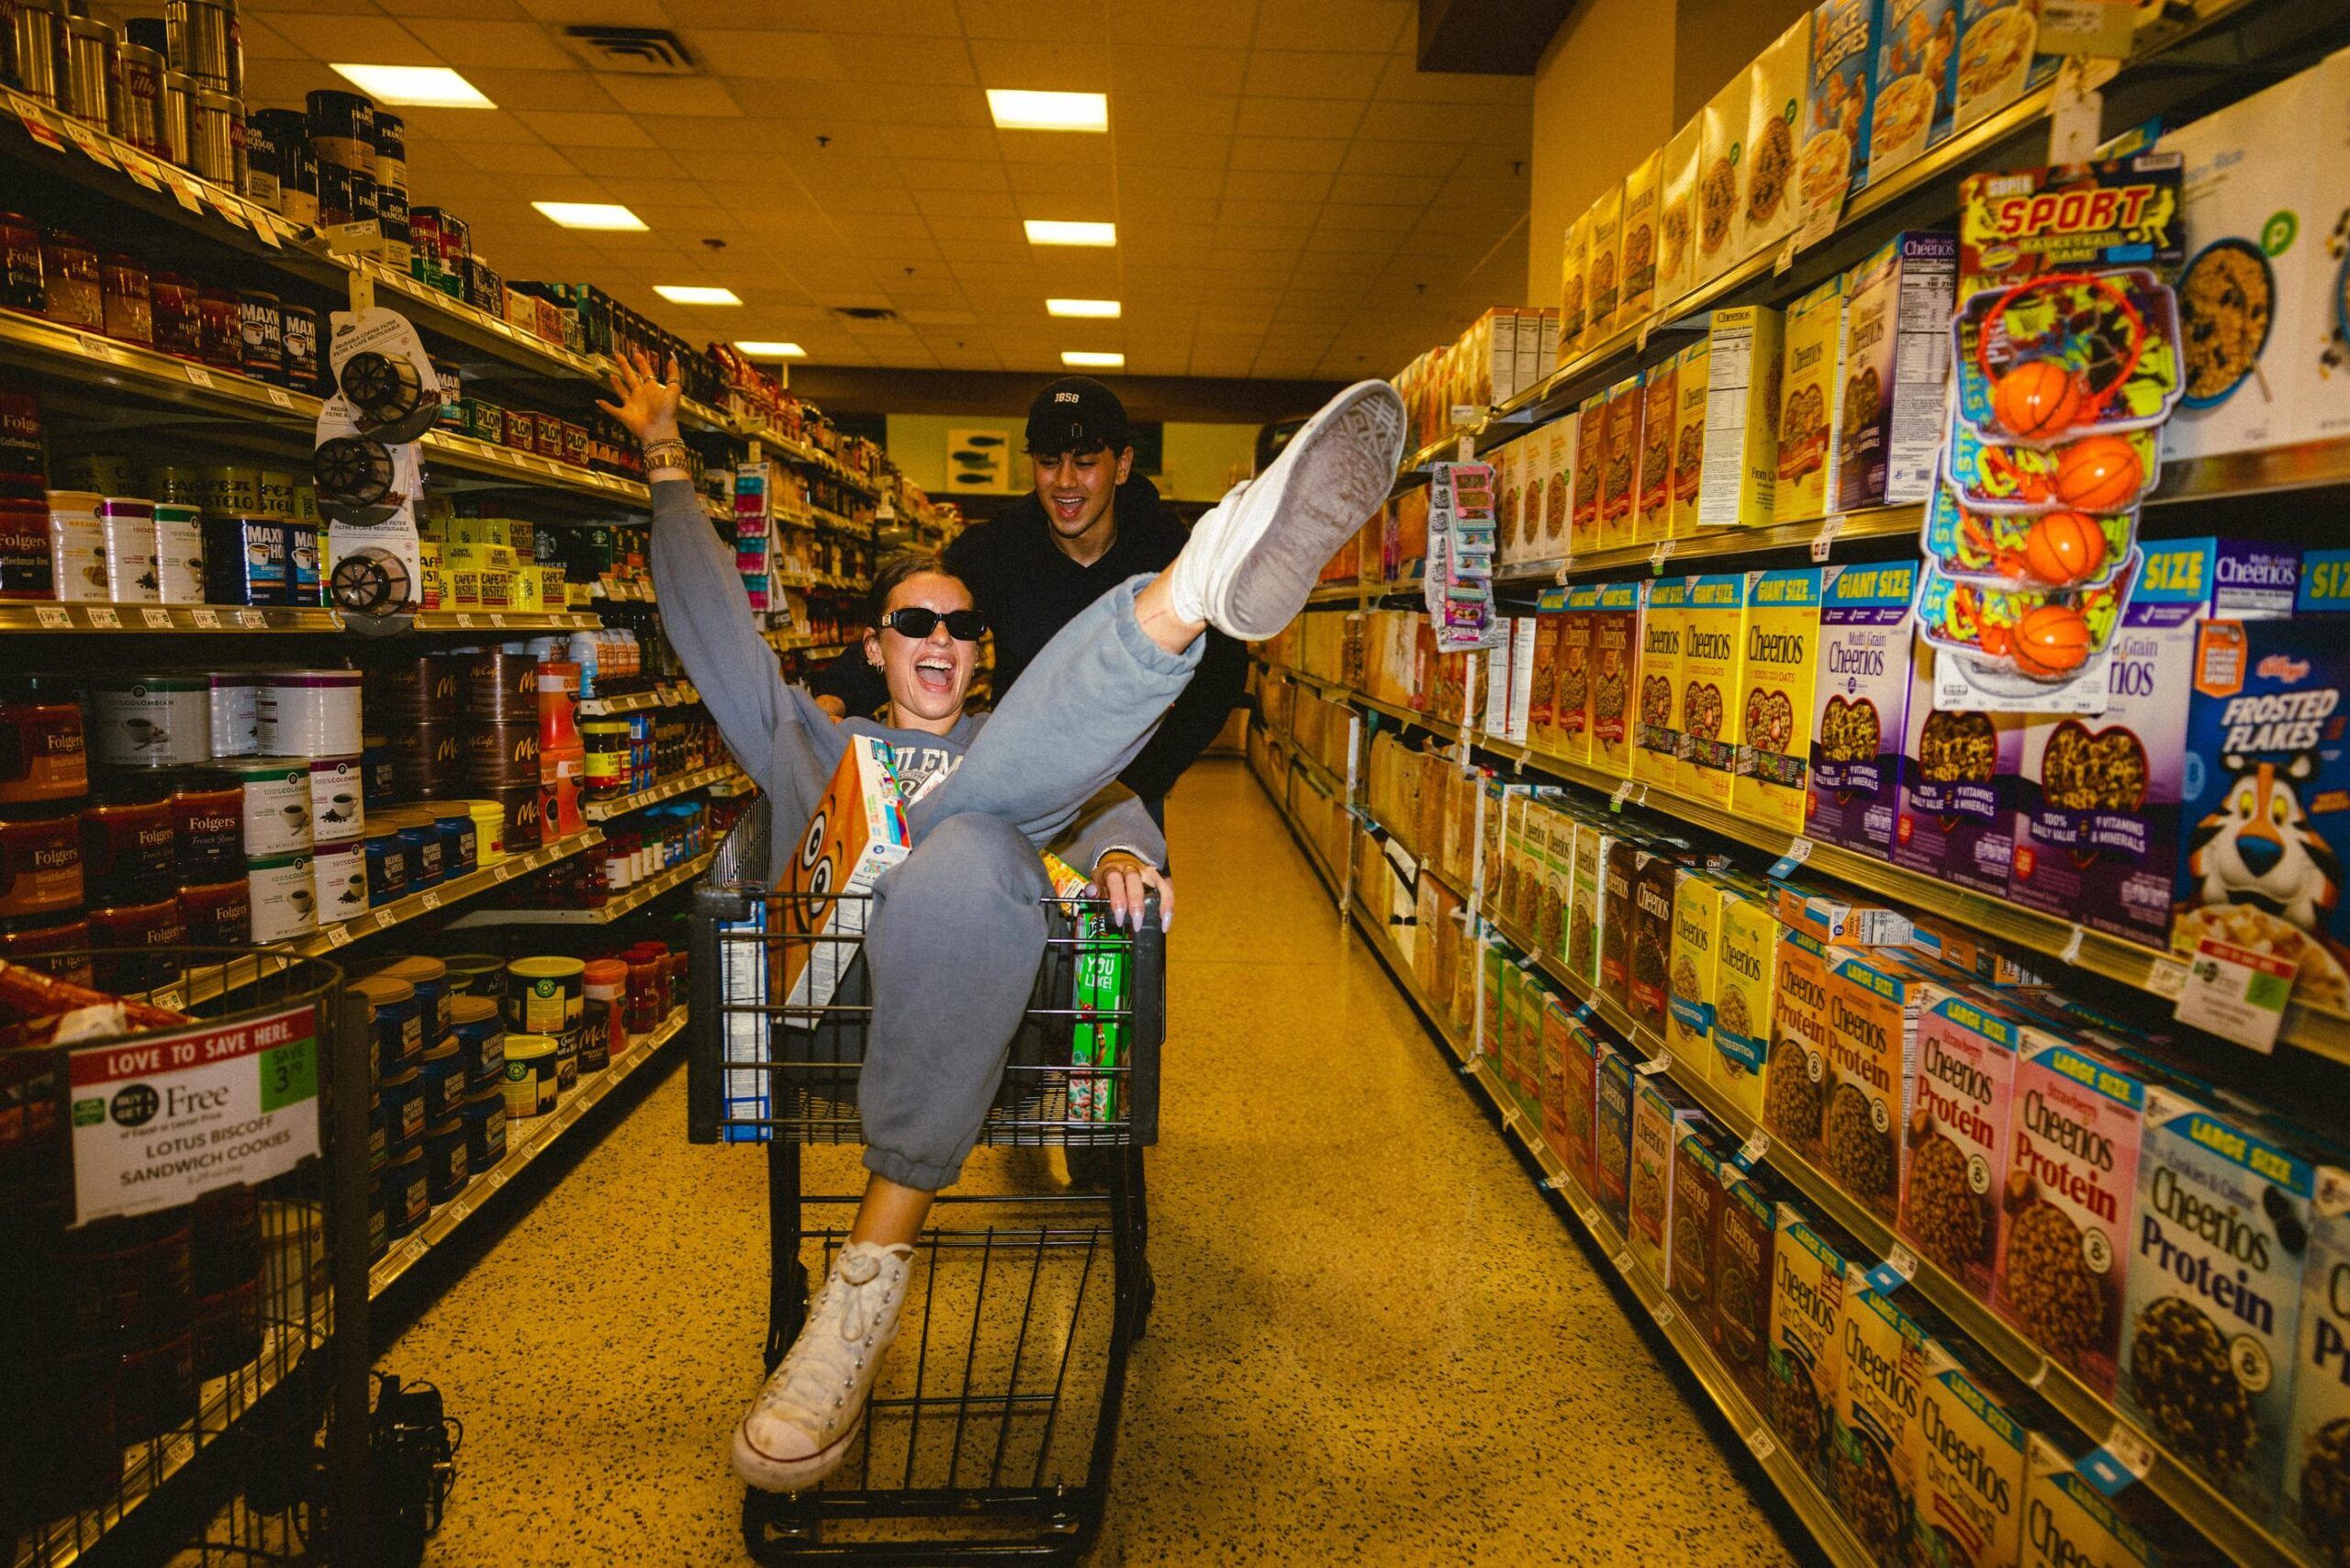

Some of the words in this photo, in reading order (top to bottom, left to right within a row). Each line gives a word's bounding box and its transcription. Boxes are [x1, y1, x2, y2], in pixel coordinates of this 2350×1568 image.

[2000, 186, 2154, 234] SPORT
[1904, 241, 1954, 256] Cheerios
[335, 333, 360, 350] REUSABLE
[361, 326, 379, 338] COFFEE
[380, 319, 397, 330] FILTER
[1718, 311, 1751, 324] Cheerios
[333, 347, 350, 357] FILTRE
[1054, 393, 1080, 403] 1858
[509, 419, 532, 435] PILON
[540, 422, 561, 441] PILON
[1838, 571, 1878, 599] GIANT
[1878, 569, 1911, 598] SIZE
[2143, 552, 2203, 590] SIZE
[2215, 556, 2297, 585] Cheerios
[1757, 580, 1785, 602] GIANT
[1785, 578, 1808, 601] SIZE
[1646, 624, 1679, 654] Cheerios
[1687, 624, 1730, 660] Cheerios
[1750, 625, 1803, 665] Cheerios
[1849, 632, 1866, 646] Multi
[1867, 632, 1886, 647] Grain
[2125, 635, 2158, 656] Grain
[1830, 641, 1885, 676] Cheerios
[1778, 672, 1795, 683] OATS
[2220, 688, 2340, 727] FROSTED
[48, 734, 84, 751] Folgers
[2221, 719, 2325, 753] FLAKES
[1821, 765, 1835, 776] 100%
[1854, 765, 1878, 779] VITAMINS
[1852, 778, 1879, 791] MINERALS
[1910, 793, 1928, 808] DAILY
[1928, 798, 1944, 811] VALUE
[1961, 799, 1995, 817] MINERALS
[1919, 785, 1938, 797] 100%
[1963, 786, 1994, 801] VITAMINS
[139, 828, 173, 846] Folgers
[189, 816, 236, 832] Folgers
[192, 835, 216, 846] French
[2031, 822, 2053, 838] DAILY
[2053, 828, 2077, 843] VALUE
[2098, 831, 2146, 854] MINERALS
[2042, 812, 2068, 827] 100%
[2102, 816, 2144, 837] VITAMINS
[34, 846, 79, 866] Folgers
[216, 902, 247, 920] Folgers
[1637, 881, 1670, 922] Cheerios
[1676, 911, 1707, 951] Cheerios
[1722, 935, 1762, 981] Cheerios
[1781, 960, 1826, 1011] Cheerios
[1847, 964, 1873, 988] LARGE
[1874, 977, 1895, 998] SIZE
[1776, 992, 1826, 1047] Protein
[1830, 995, 1887, 1055] Cheerios
[1947, 1002, 1981, 1030] LARGE
[1982, 1018, 2008, 1043] SIZE
[108, 1048, 162, 1076] LOVE
[172, 1047, 196, 1065] TO
[205, 1033, 248, 1058] SAVE
[253, 1024, 293, 1047] HERE.
[1828, 1029, 1891, 1093] Protein
[1924, 1036, 1993, 1105] Cheerios
[2052, 1050, 2096, 1086] LARGE
[2097, 1071, 2131, 1101] SIZE
[165, 1083, 229, 1118] Free
[1918, 1074, 1994, 1150] Protein
[146, 1132, 206, 1159] LOTUS
[210, 1115, 274, 1145] BISCOFF
[2025, 1089, 2114, 1171] Cheerios
[120, 1150, 222, 1186] SANDWICH
[227, 1129, 291, 1159] COOKIES
[2189, 1116, 2247, 1162] LARGE
[2249, 1147, 2293, 1184] SIZE
[2015, 1131, 2118, 1224] Protein
[2153, 1166, 2269, 1271] Cheerios
[2141, 1215, 2274, 1336] Protein
[1777, 1251, 1835, 1336] Cheerios
[1845, 1318, 1918, 1418] Cheerios
[1922, 1395, 2010, 1516] Cheerios
